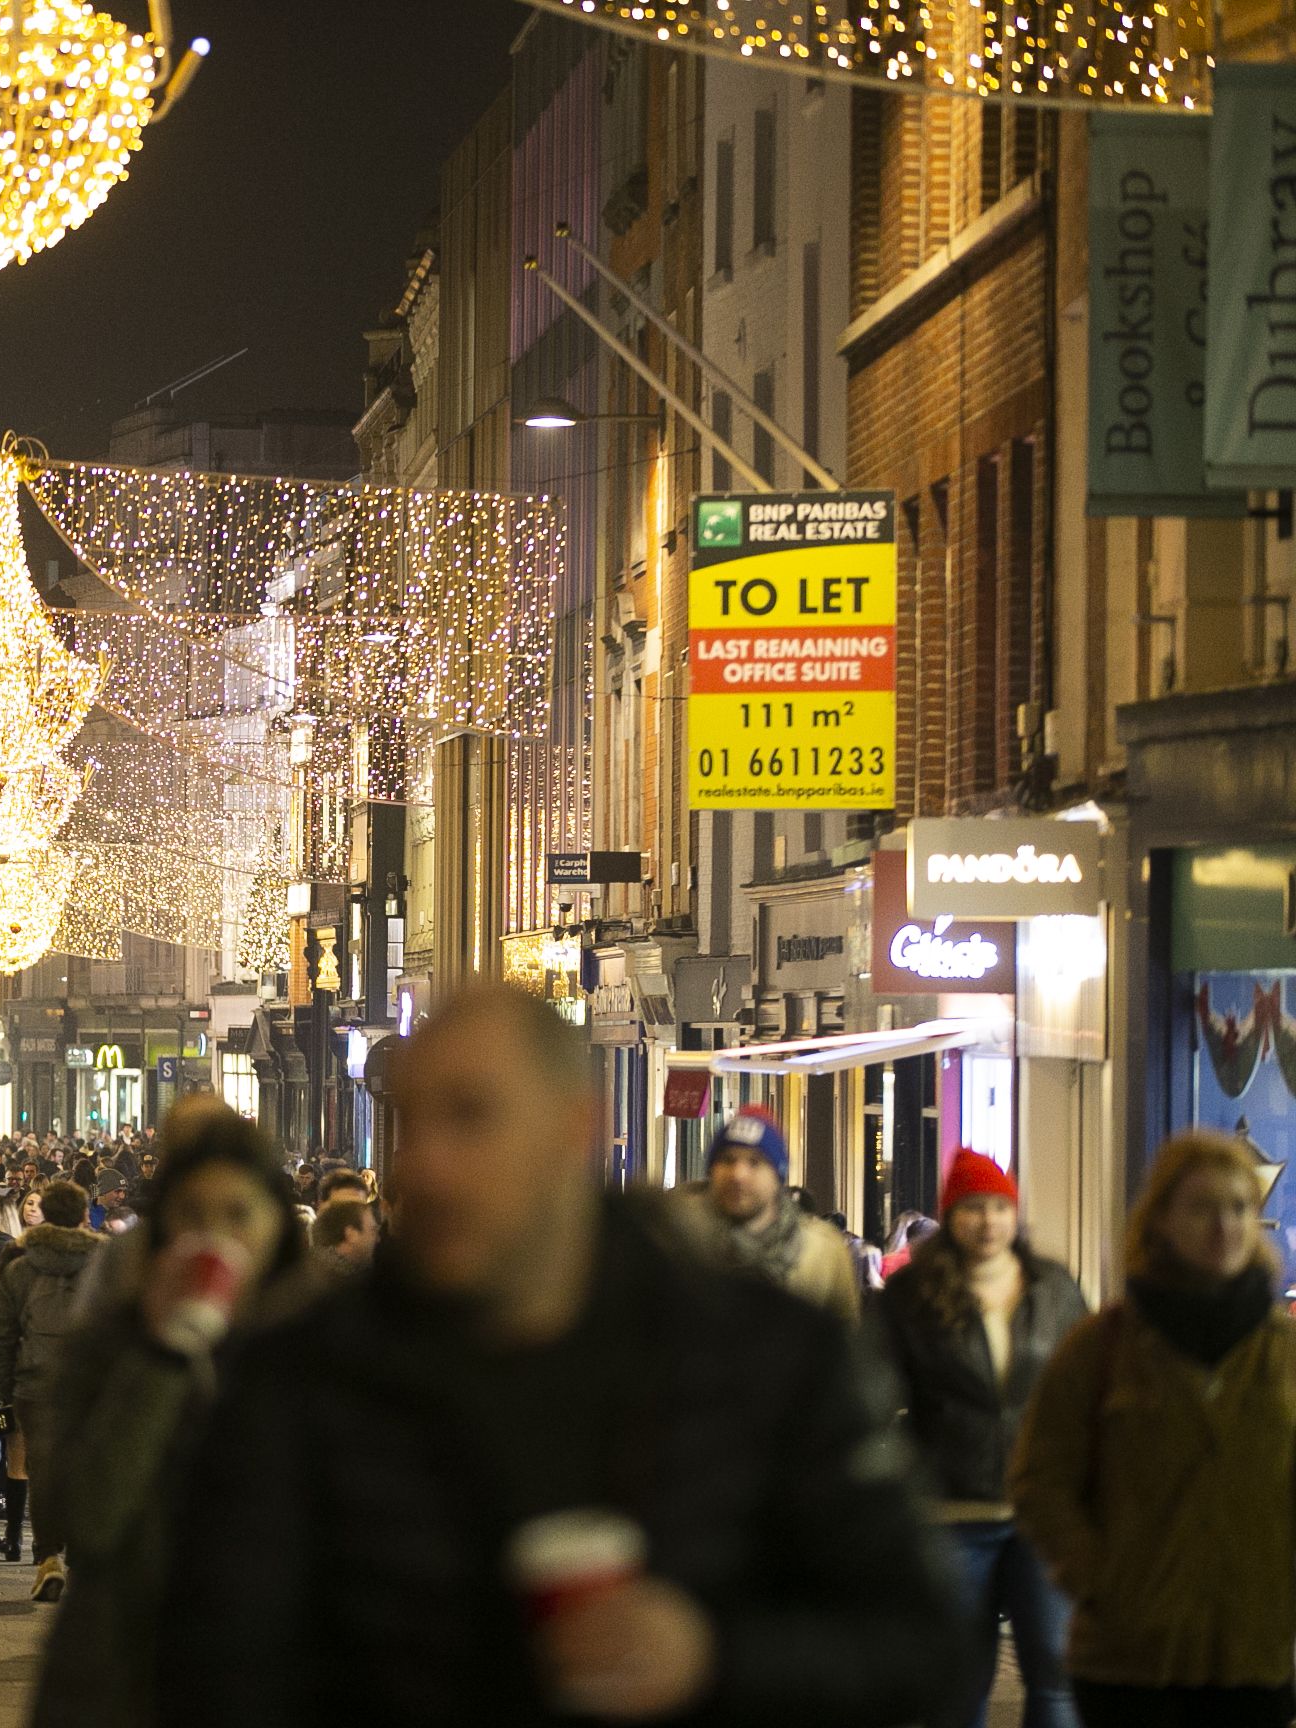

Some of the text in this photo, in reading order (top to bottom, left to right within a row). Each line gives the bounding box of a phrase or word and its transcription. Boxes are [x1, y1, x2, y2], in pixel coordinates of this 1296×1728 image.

[1106, 169, 1168, 458] Bookshop
[749, 501, 887, 522] BNP PARIBAS
[749, 521, 880, 542] REAL ESTATE
[715, 577, 869, 616] TO LET
[697, 637, 888, 660] LAST REMAINING
[723, 661, 862, 684] OFFICE SUITE
[741, 703, 793, 728] 111
[699, 747, 885, 777] 01 6611233
[698, 783, 885, 800] realestate.bnpparibas.ie
